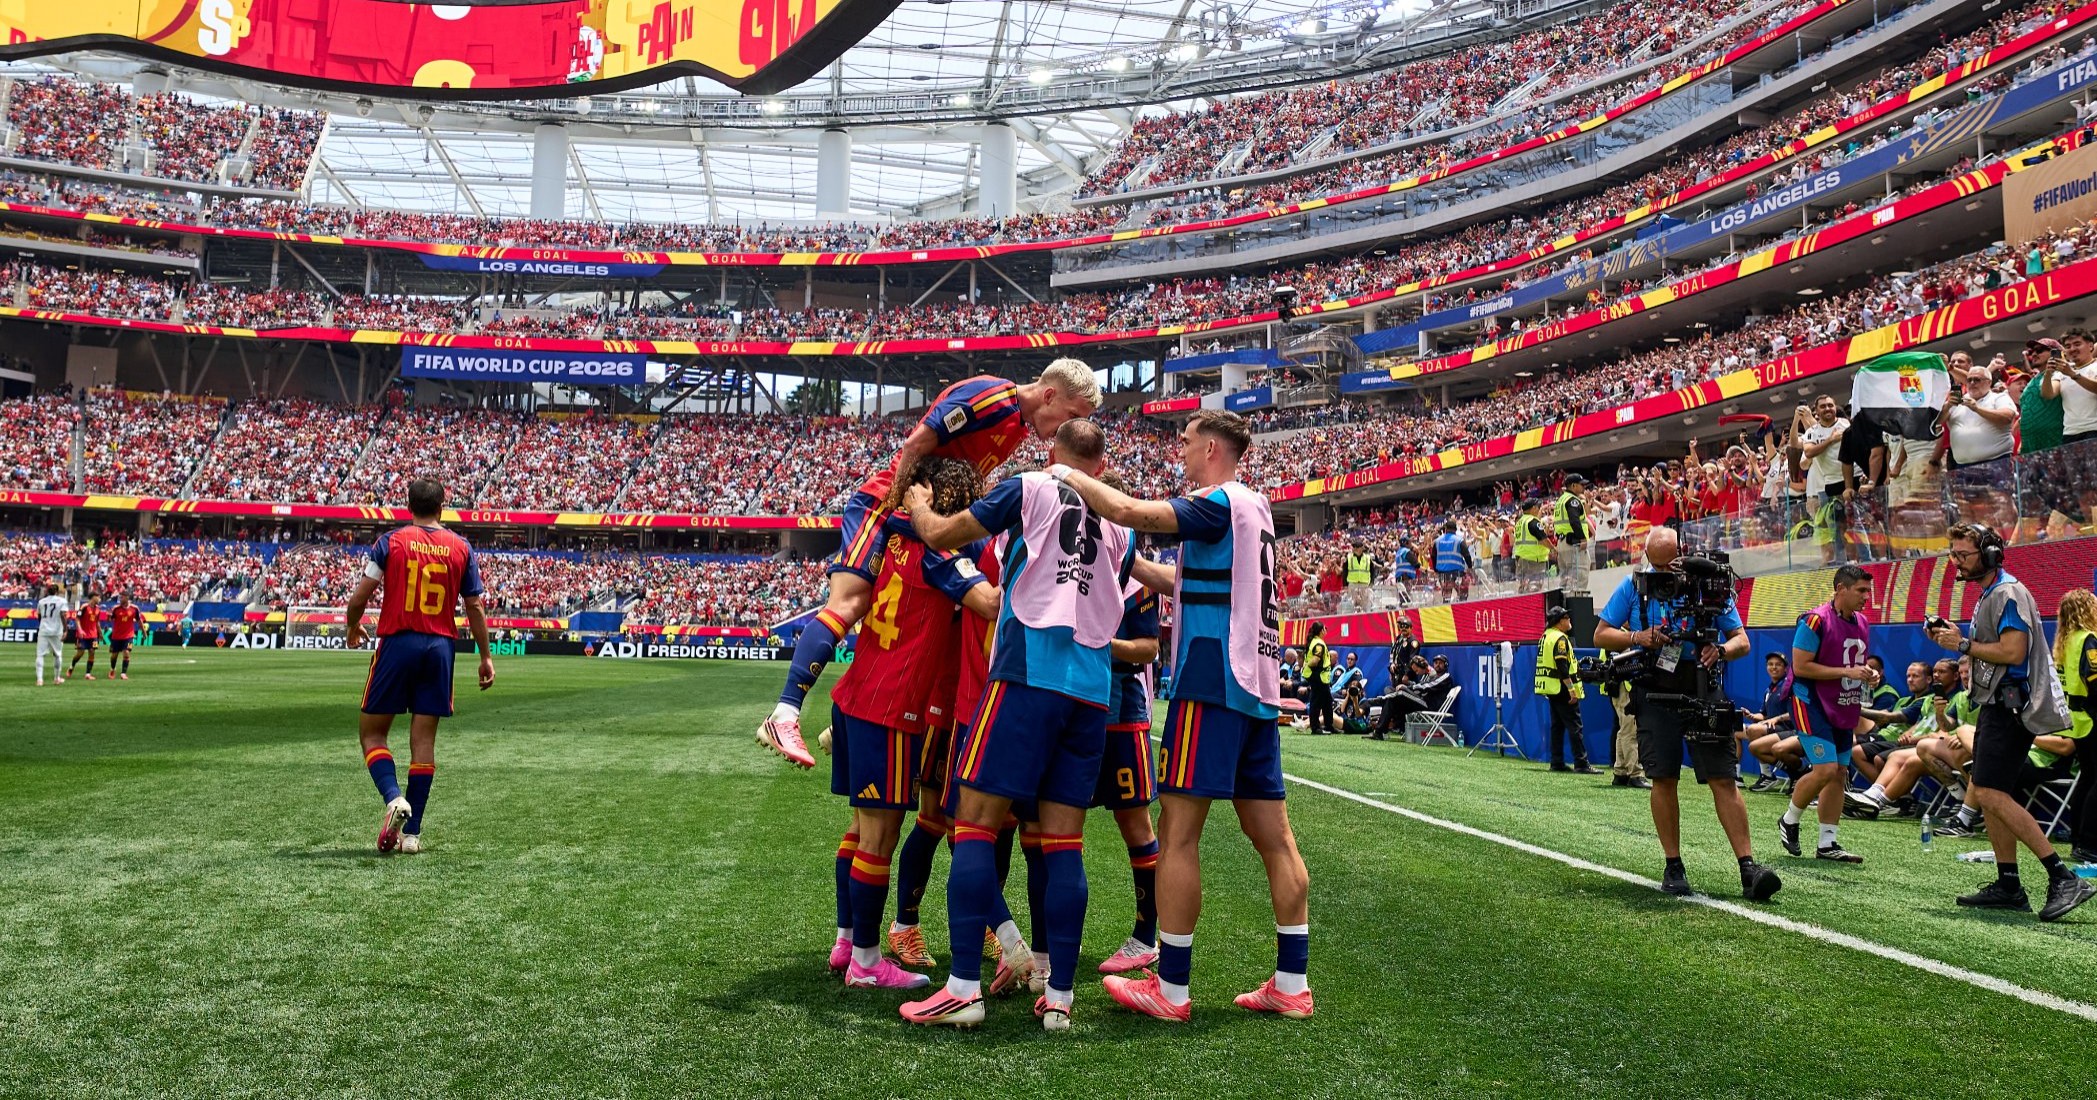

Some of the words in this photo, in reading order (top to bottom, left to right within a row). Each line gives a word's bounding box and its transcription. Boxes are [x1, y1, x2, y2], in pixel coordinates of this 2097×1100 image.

[1711, 207, 1746, 234] LOS
[1750, 170, 1841, 220] ANGELES
[1872, 206, 1895, 226] SPAIN
[533, 250, 569, 260] GOAL
[711, 254, 746, 264] GOAL
[479, 261, 517, 272] LOS
[521, 262, 609, 276] ANGELES
[1672, 275, 1707, 297] GOAL
[1983, 275, 2060, 320] GOAL
[1537, 322, 1568, 342] GOAL
[494, 338, 531, 348] GOAL
[711, 343, 747, 352] GOAL
[414, 354, 455, 370] FIFA
[457, 356, 526, 373] WORLD
[528, 358, 566, 374] CUP
[568, 360, 634, 376] 2026
[1418, 361, 1451, 374] GOAL
[1753, 363, 1803, 388] GOAL
[1150, 402, 1172, 412] GOAL
[1615, 406, 1635, 424] SPAIN
[1461, 445, 1490, 463] GOAL
[1354, 469, 1380, 486] GOAL
[471, 511, 512, 523] GOAL
[690, 516, 730, 527] GOAL
[410, 540, 450, 557] RODRIGO
[404, 559, 448, 615] 16
[43, 603, 56, 619] 17
[864, 571, 903, 650] 4
[1475, 608, 1504, 633] GOAL
[230, 633, 277, 649] ADI
[598, 643, 643, 658] ADI
[647, 644, 780, 660] PREDICTSTREET
[1117, 768, 1135, 799] 9
